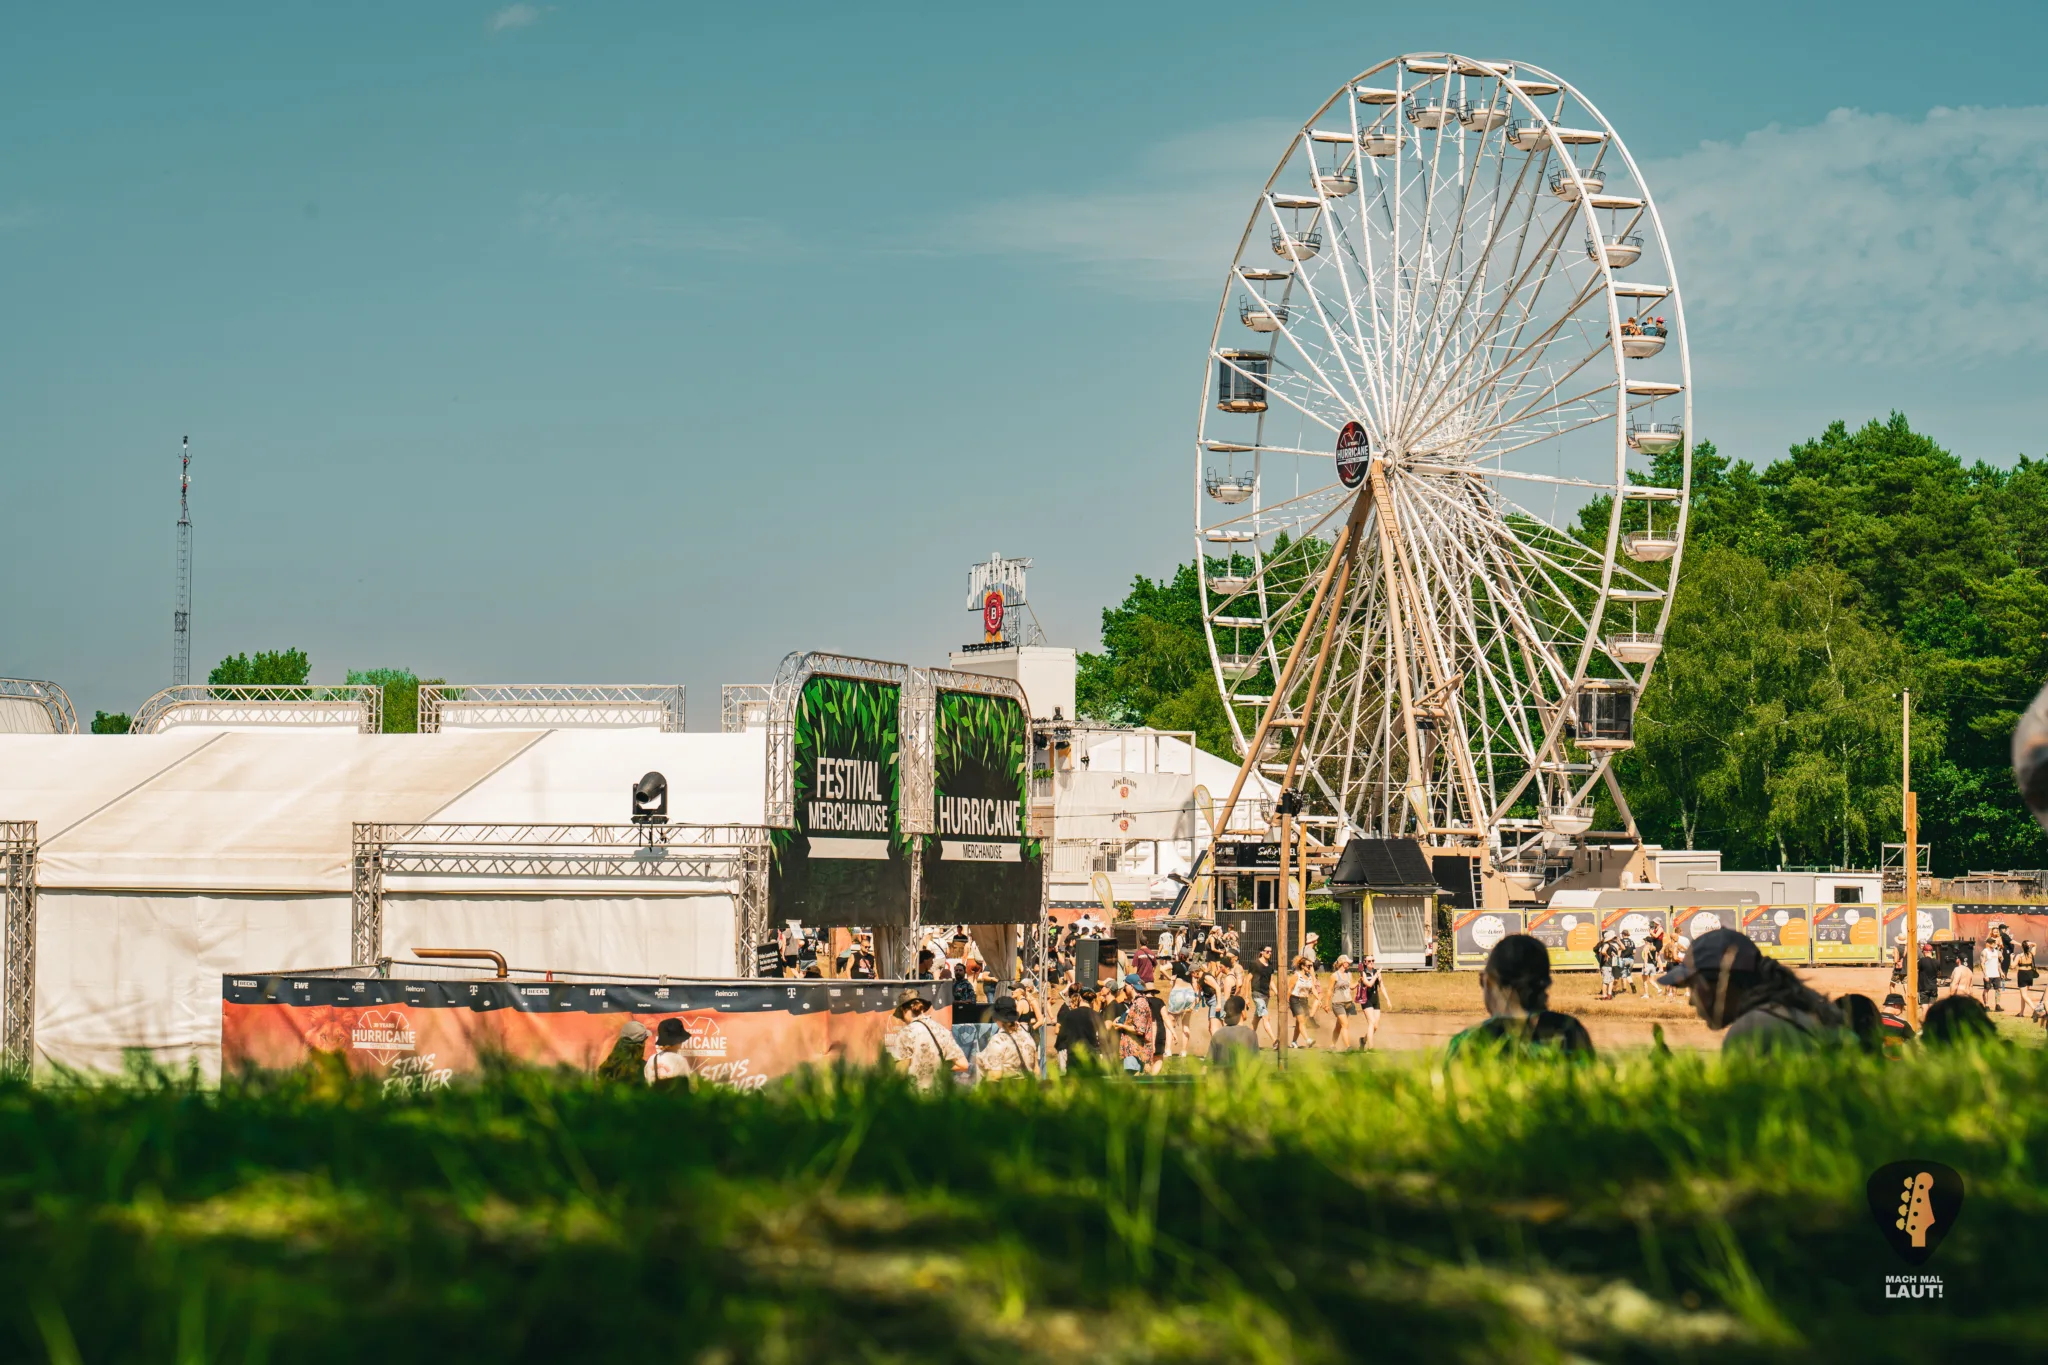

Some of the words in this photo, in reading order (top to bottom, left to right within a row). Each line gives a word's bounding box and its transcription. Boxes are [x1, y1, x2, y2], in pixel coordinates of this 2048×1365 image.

[1336, 445, 1369, 460] HURRICANE
[816, 757, 882, 801] FESTIVAL
[808, 802, 889, 832] MERCHANDISE
[939, 796, 1021, 837] HURRICANE
[962, 843, 1002, 860] MERCHANDISE
[589, 988, 606, 996] EWE
[352, 1029, 416, 1044] HURRICANE
[392, 1053, 436, 1076] STAYS
[700, 1058, 749, 1081] STAYS
[382, 1068, 453, 1099] FOREVER
